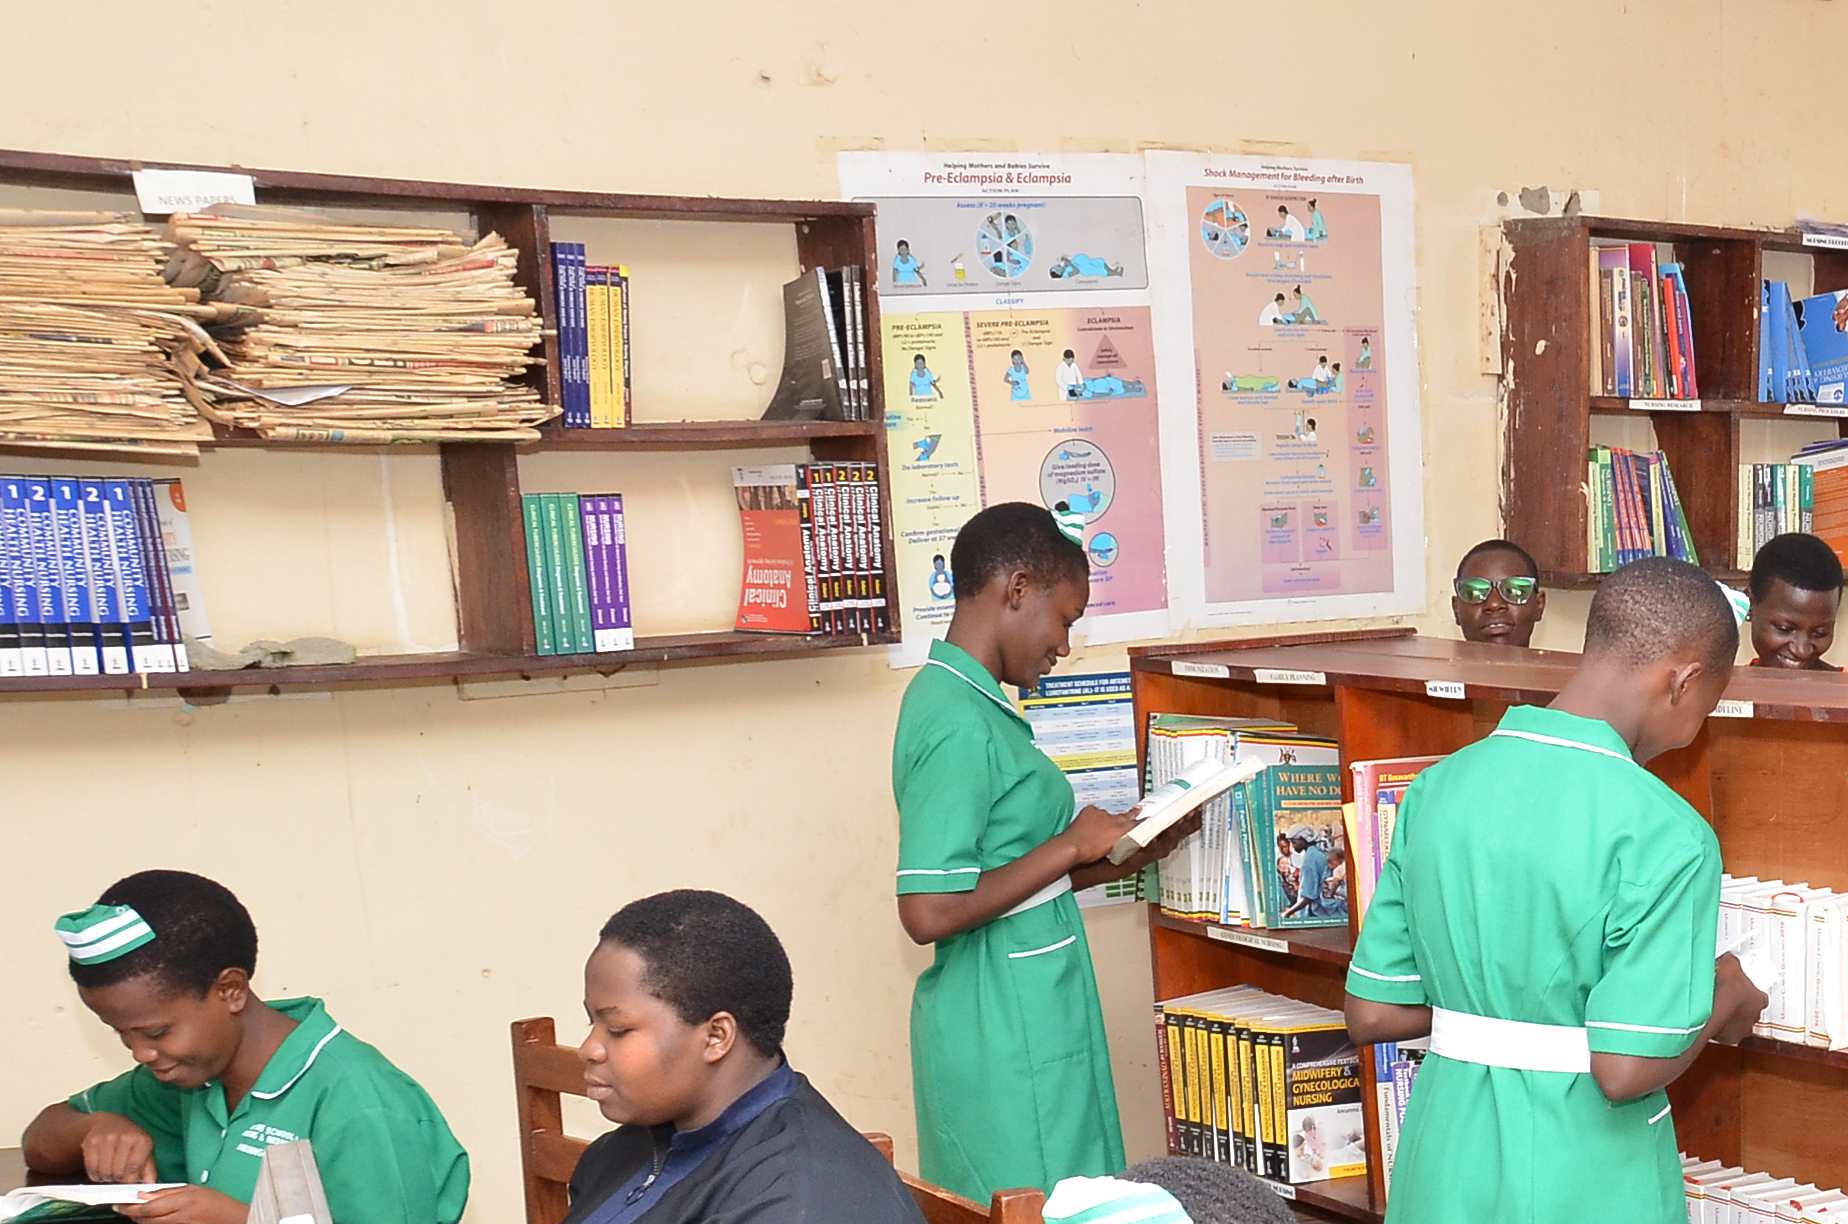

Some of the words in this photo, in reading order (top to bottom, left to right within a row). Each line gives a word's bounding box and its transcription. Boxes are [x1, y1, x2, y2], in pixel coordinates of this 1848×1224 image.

[924, 172, 1003, 186] Pre-Eclampsia
[1005, 173, 1014, 184] &
[1016, 172, 1072, 186] Eclampsia
[1204, 168, 1227, 177] Shock
[1229, 169, 1280, 181] Management
[1281, 170, 1292, 180] for
[1293, 172, 1326, 184] Bleeding
[1327, 173, 1345, 183] after
[1346, 175, 1364, 184] Birth
[96, 512, 116, 588] COMMUNITY
[122, 509, 144, 588] COMMUNITY
[746, 565, 792, 589] Anatomy
[1278, 771, 1323, 784] WHERE
[1276, 786, 1306, 797] HAVE
[1308, 786, 1327, 796] NO
[1292, 1067, 1343, 1081] MIDWIFERY
[1292, 1077, 1361, 1095] GYNECOLOGICA
[1293, 1092, 1333, 1106] NURSING
